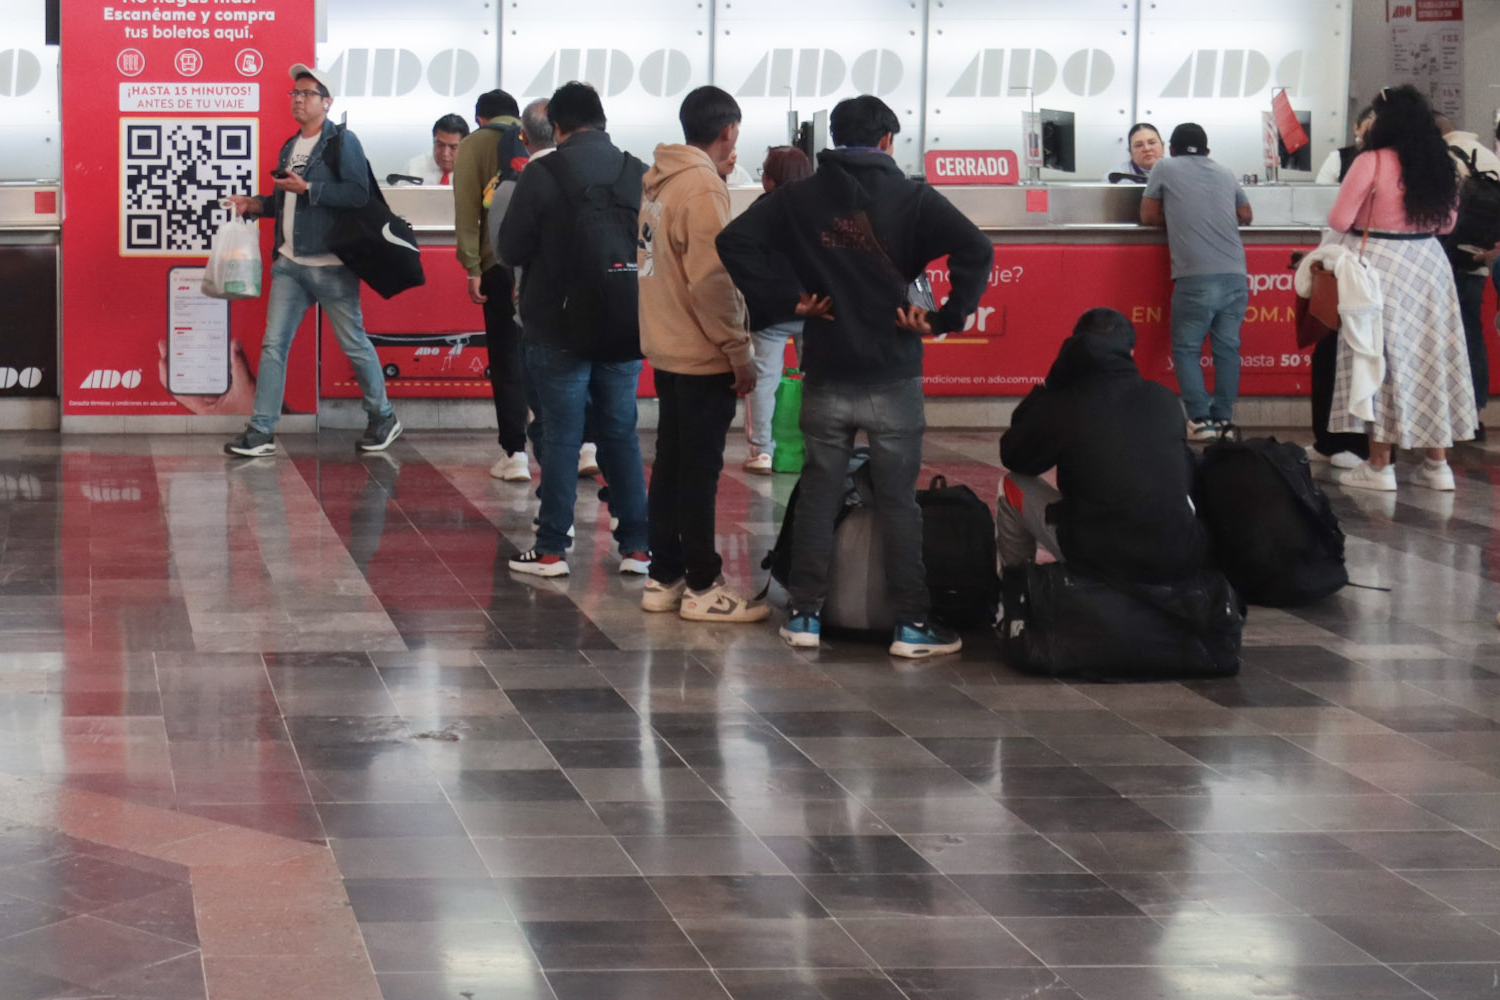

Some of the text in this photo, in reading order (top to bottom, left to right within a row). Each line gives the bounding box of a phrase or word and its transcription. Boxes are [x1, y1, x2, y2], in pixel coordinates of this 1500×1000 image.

[103, 7, 276, 24] Escanéame y compra
[125, 25, 254, 42] tus boletos aquí.
[325, 48, 480, 97] ADO
[521, 48, 692, 97] ADO
[734, 48, 903, 97] ADO
[946, 48, 1115, 98] ADO
[127, 86, 252, 98] ¡HASTA 15 MINUTOS!
[137, 99, 244, 109] ANTES DE TU VIAJE
[935, 156, 1009, 177] CERRADO
[1132, 306, 1162, 323] EN
[79, 369, 142, 389] ADO
[973, 376, 986, 384] en
